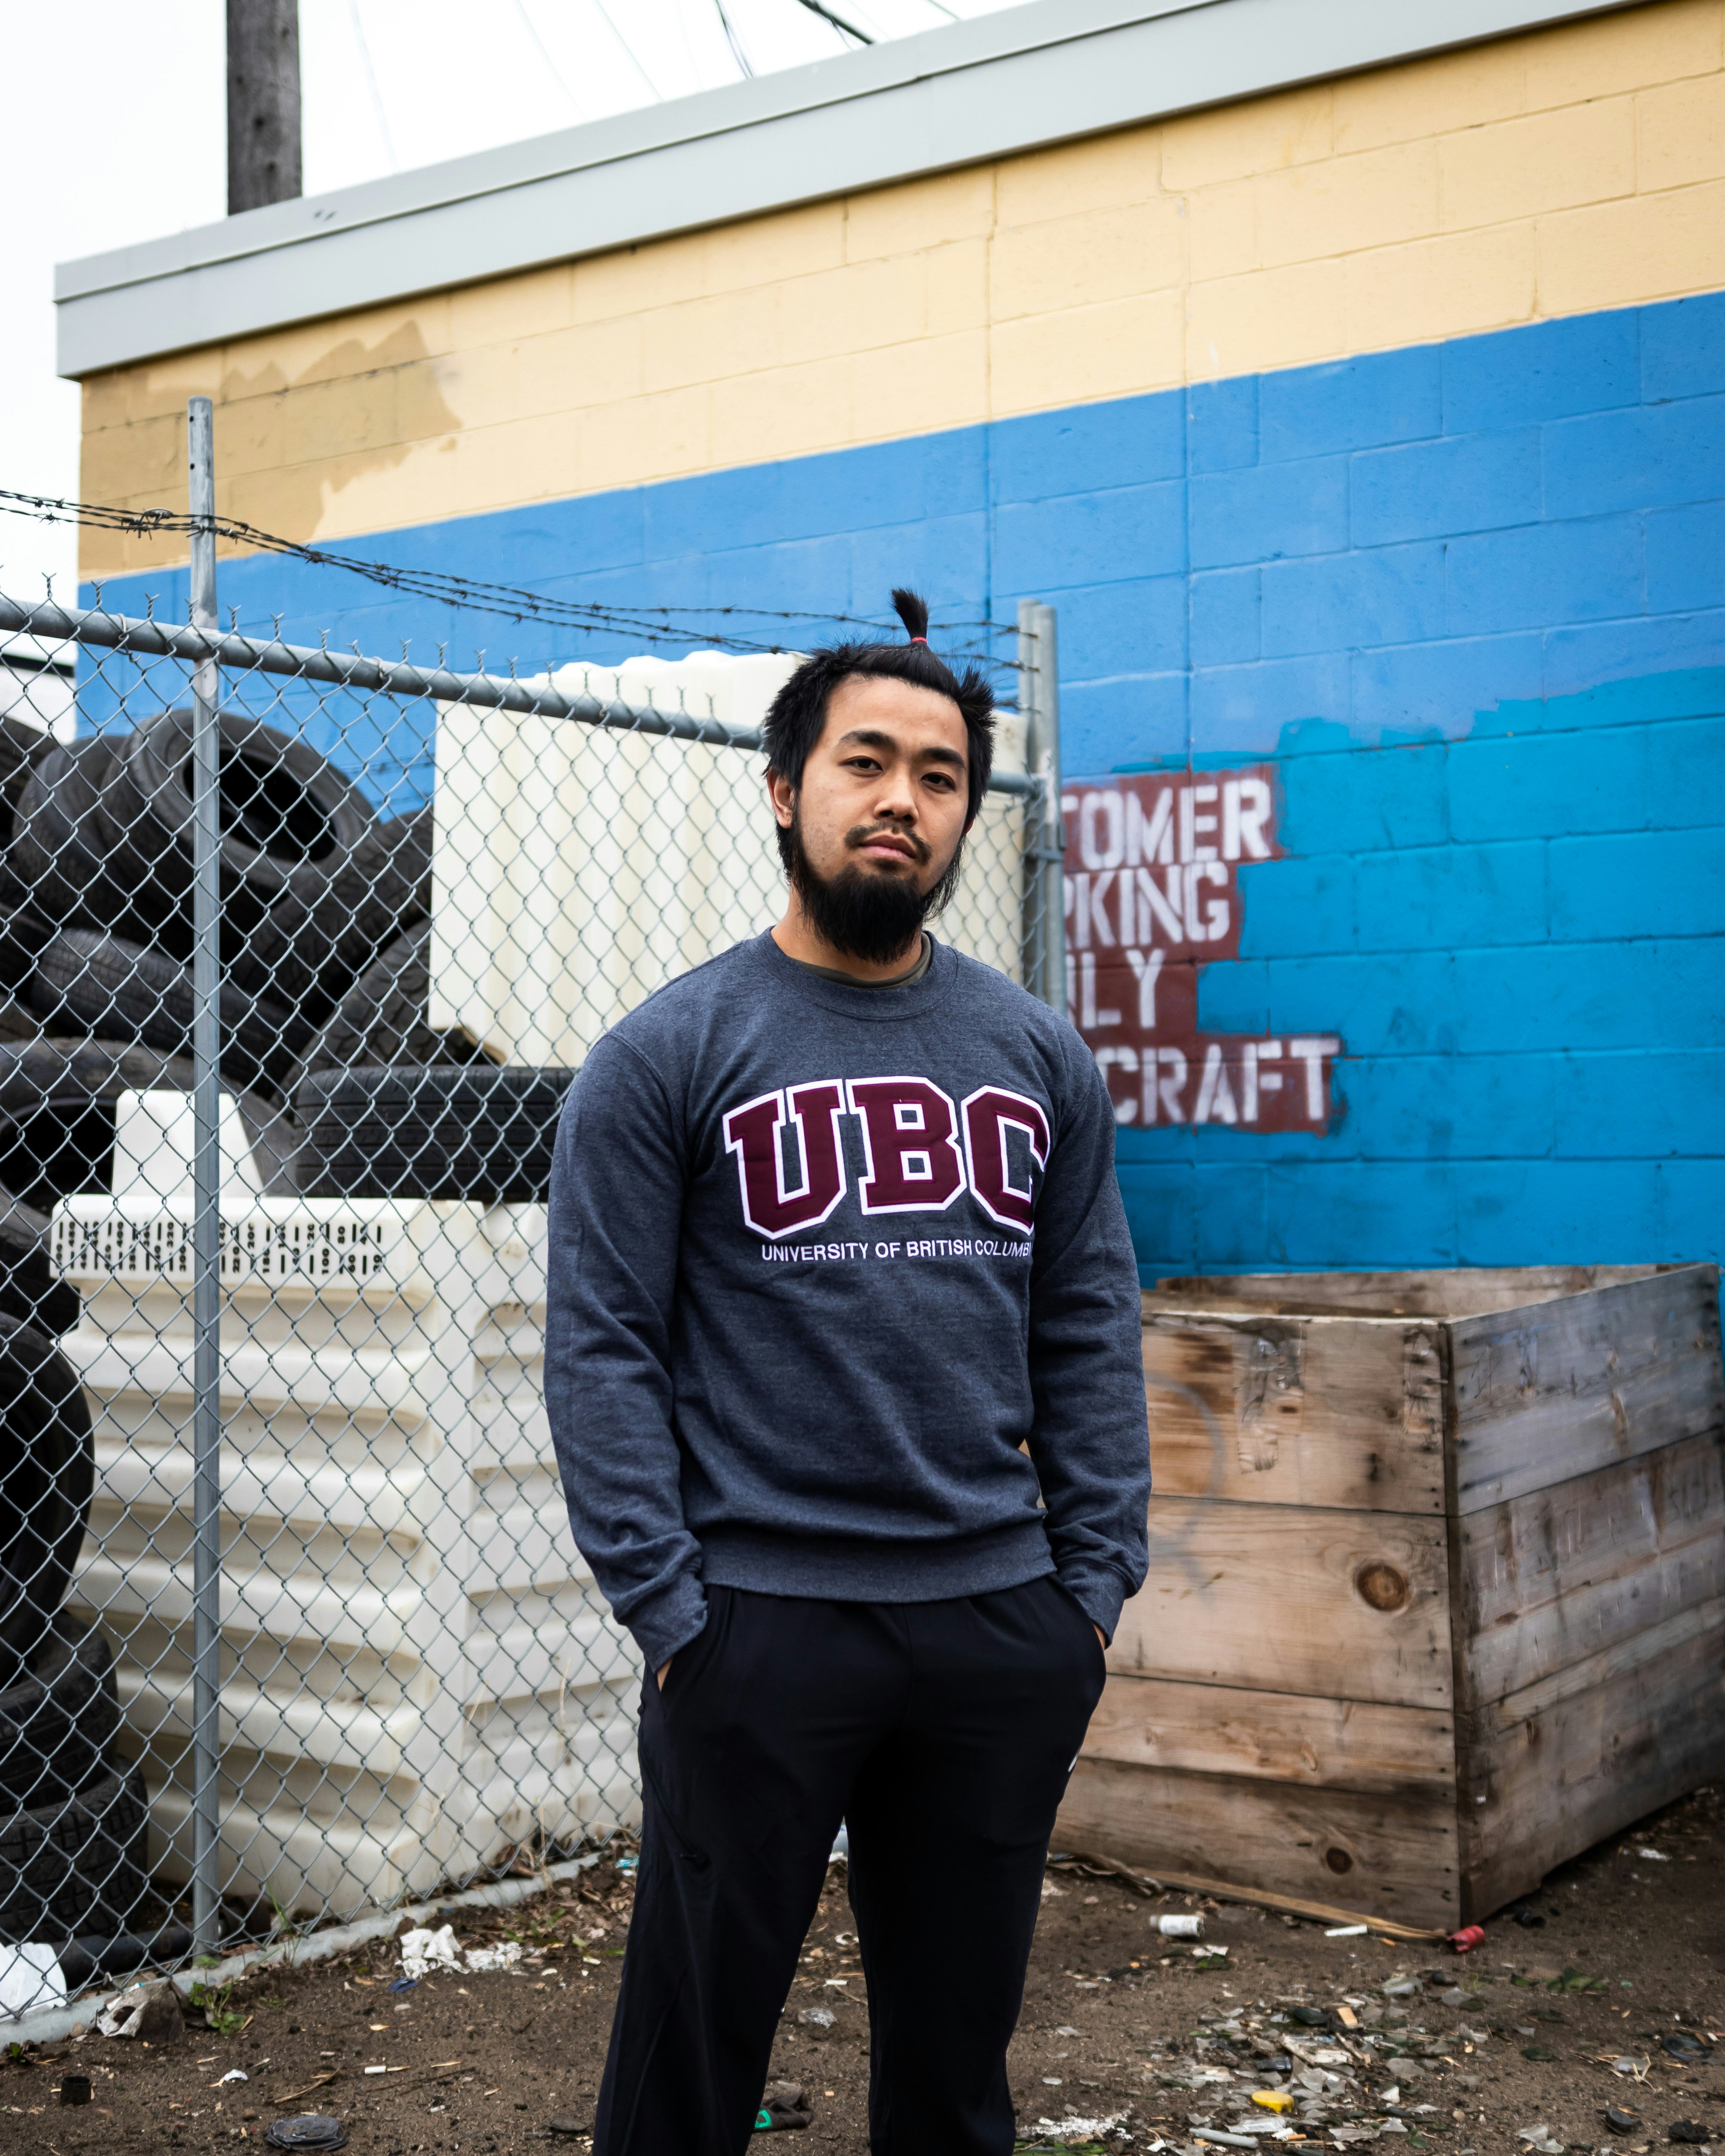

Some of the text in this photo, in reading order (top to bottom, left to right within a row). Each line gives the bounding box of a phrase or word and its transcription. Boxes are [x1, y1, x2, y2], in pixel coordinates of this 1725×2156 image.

[722, 1075, 1051, 1240] UBC
[338, 1226, 345, 1244] 80
[762, 1242, 869, 1262] UNIVERSITY
[875, 1242, 901, 1258] OF
[906, 1239, 973, 1257] BRITISH
